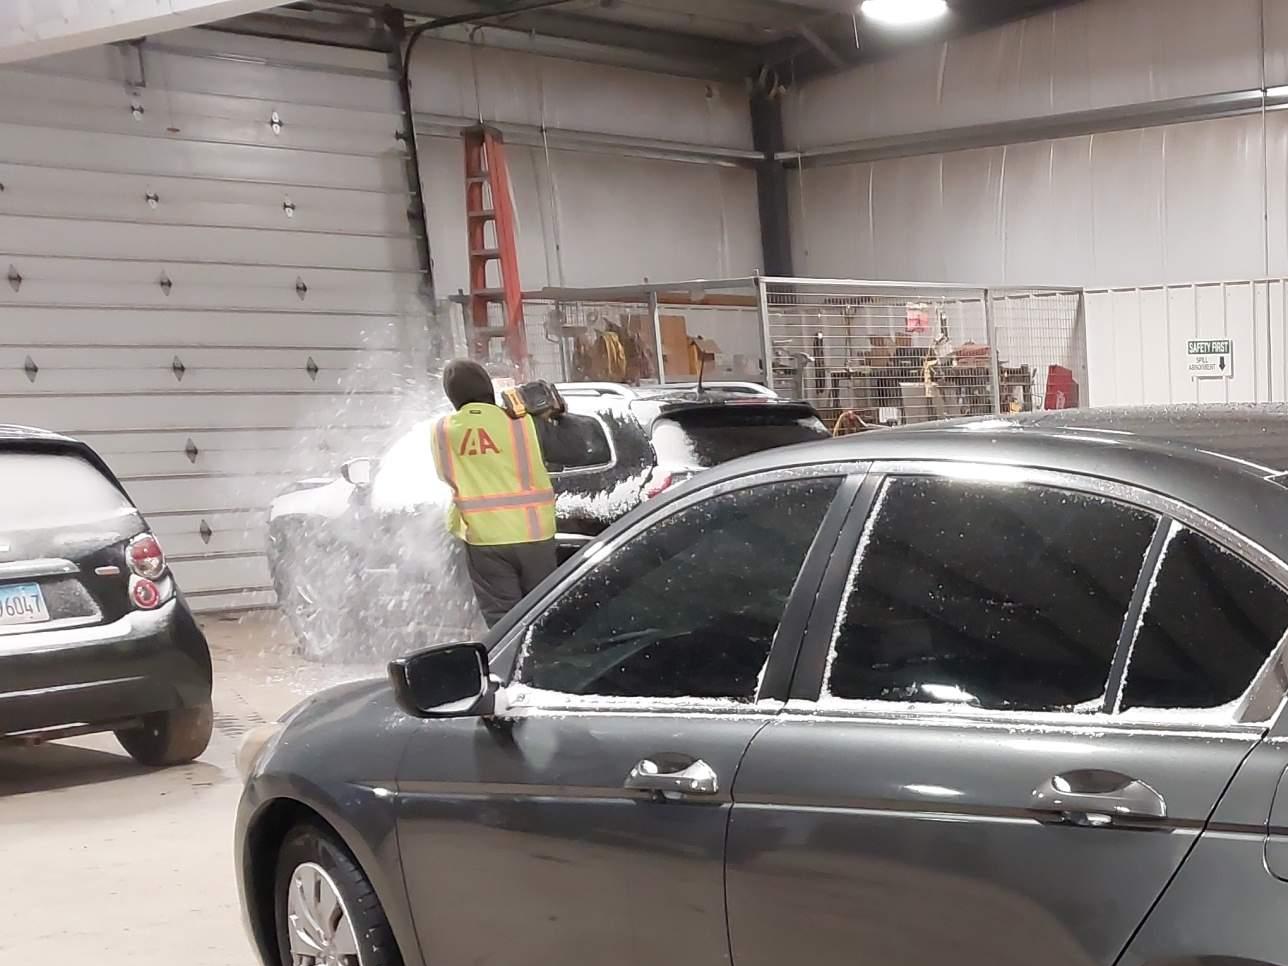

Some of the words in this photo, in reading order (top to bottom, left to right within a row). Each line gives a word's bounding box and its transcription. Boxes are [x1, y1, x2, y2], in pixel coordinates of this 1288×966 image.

[1189, 342, 1210, 353] SAFETY
[1211, 341, 1229, 353] FIRST
[0, 594, 41, 617] 6047
